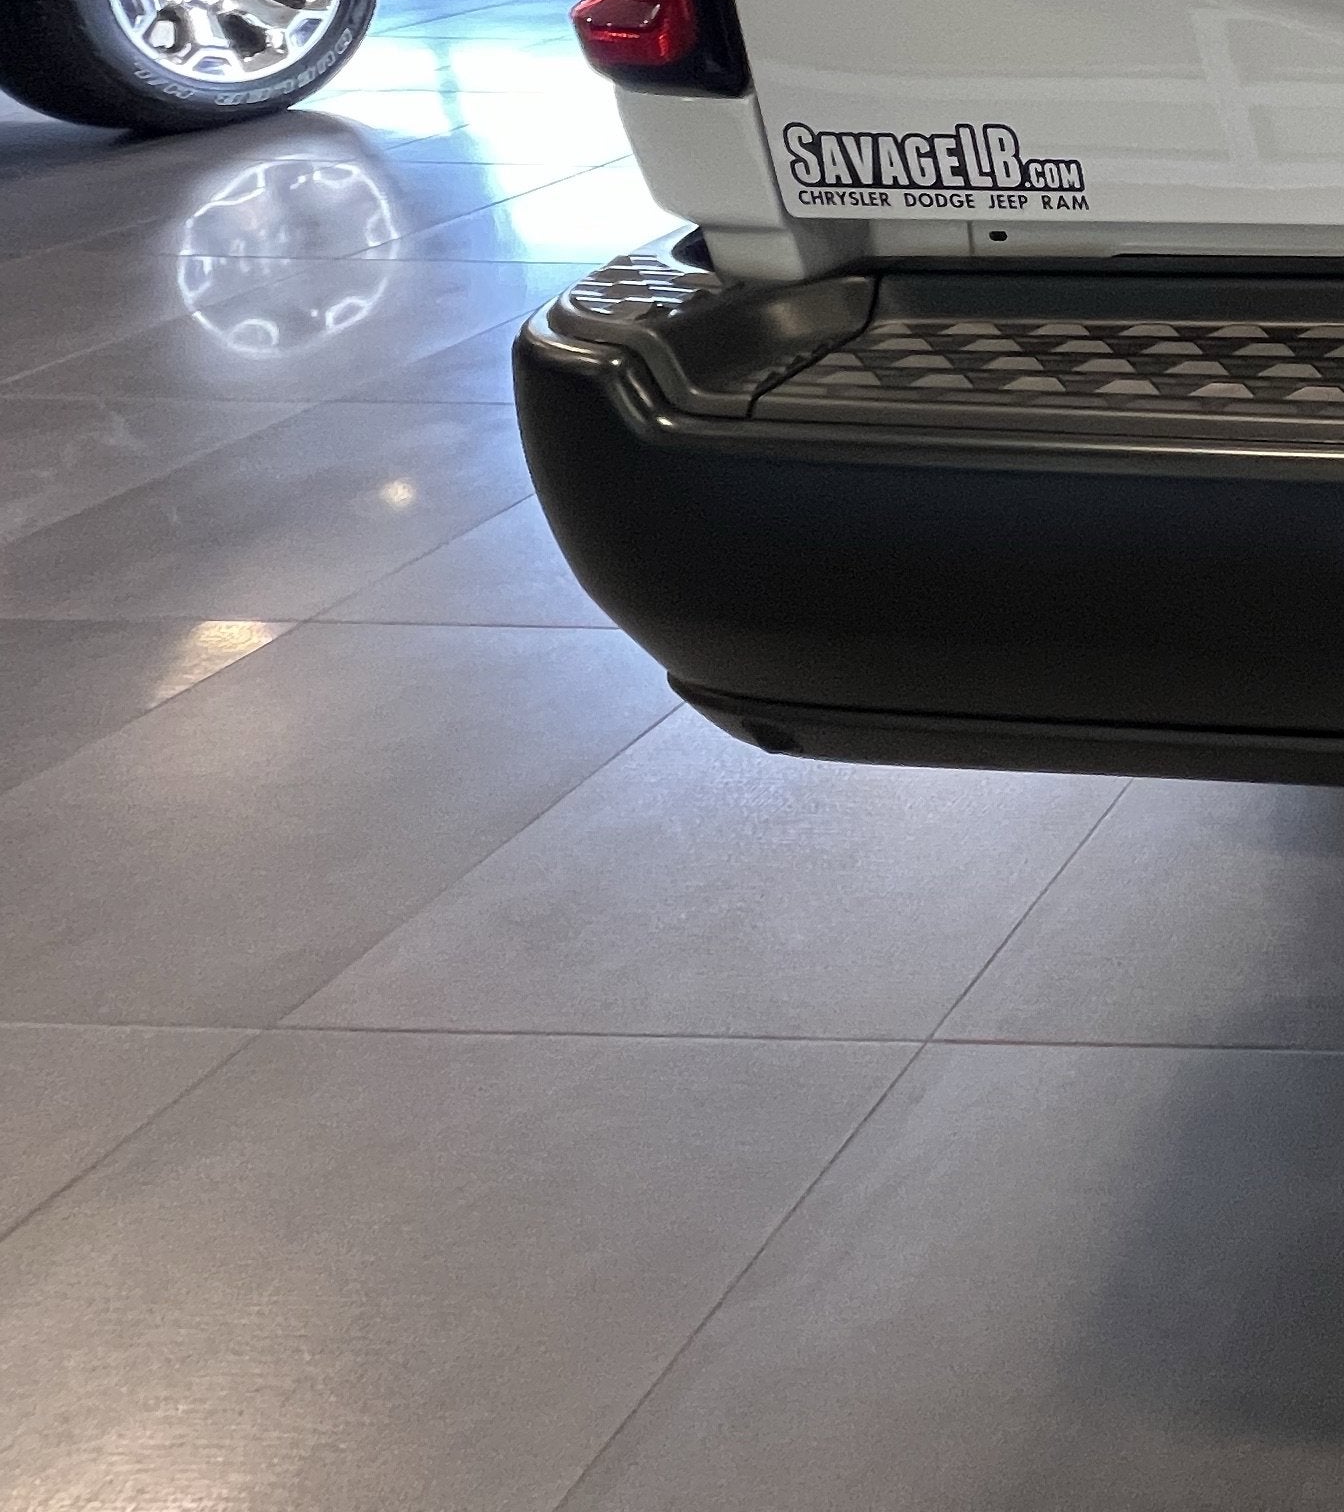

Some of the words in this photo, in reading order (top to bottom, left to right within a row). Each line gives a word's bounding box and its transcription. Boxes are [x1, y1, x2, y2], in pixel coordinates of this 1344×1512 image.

[798, 191, 892, 207] CHRYSLER
[905, 193, 975, 208] DODGE
[988, 194, 1028, 209] JEEP
[1042, 195, 1089, 210] RAM
